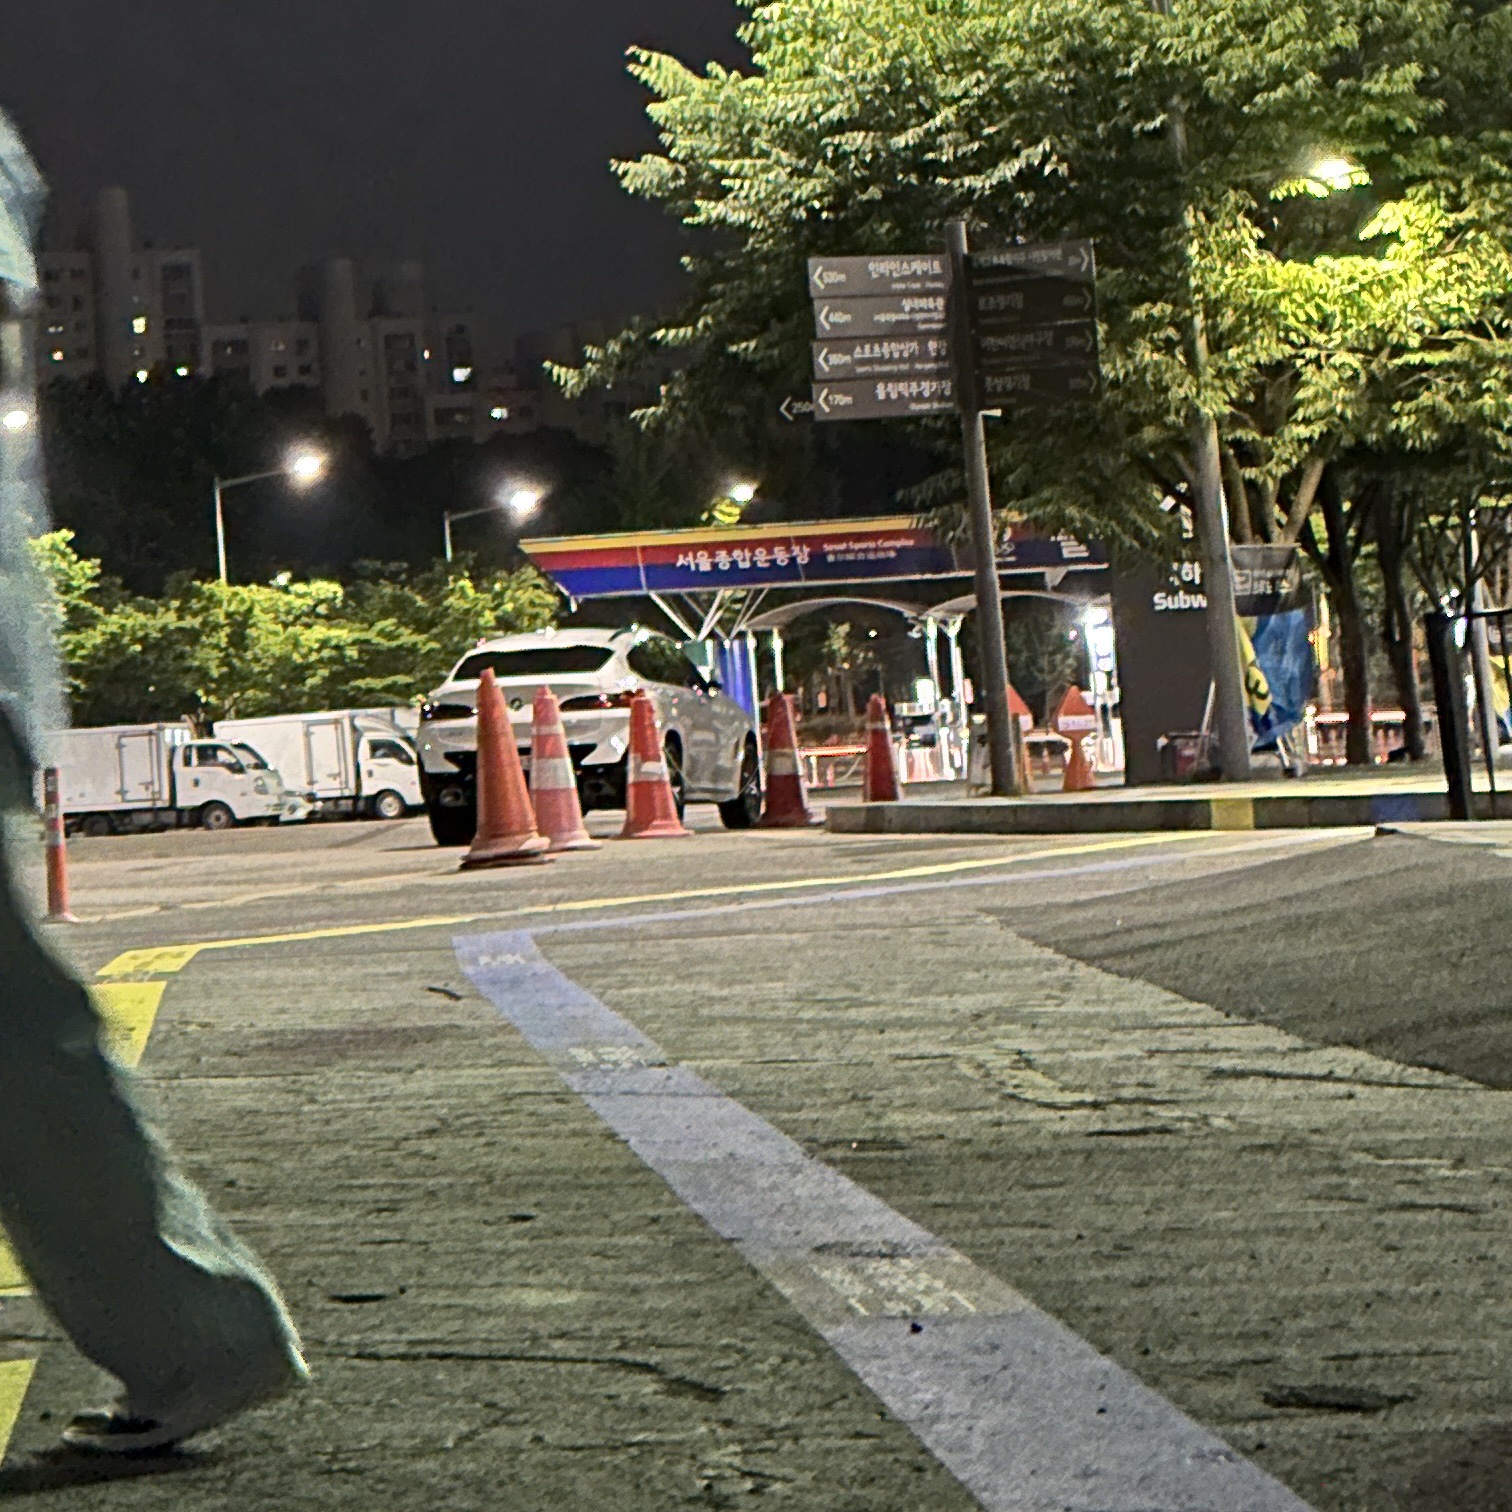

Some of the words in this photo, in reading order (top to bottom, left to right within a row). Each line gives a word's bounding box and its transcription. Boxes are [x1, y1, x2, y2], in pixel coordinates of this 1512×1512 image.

[875, 380, 953, 400] 올림픽주경기장
[676, 544, 811, 572] 서울종합운동장
[1153, 589, 1208, 611] Subw
